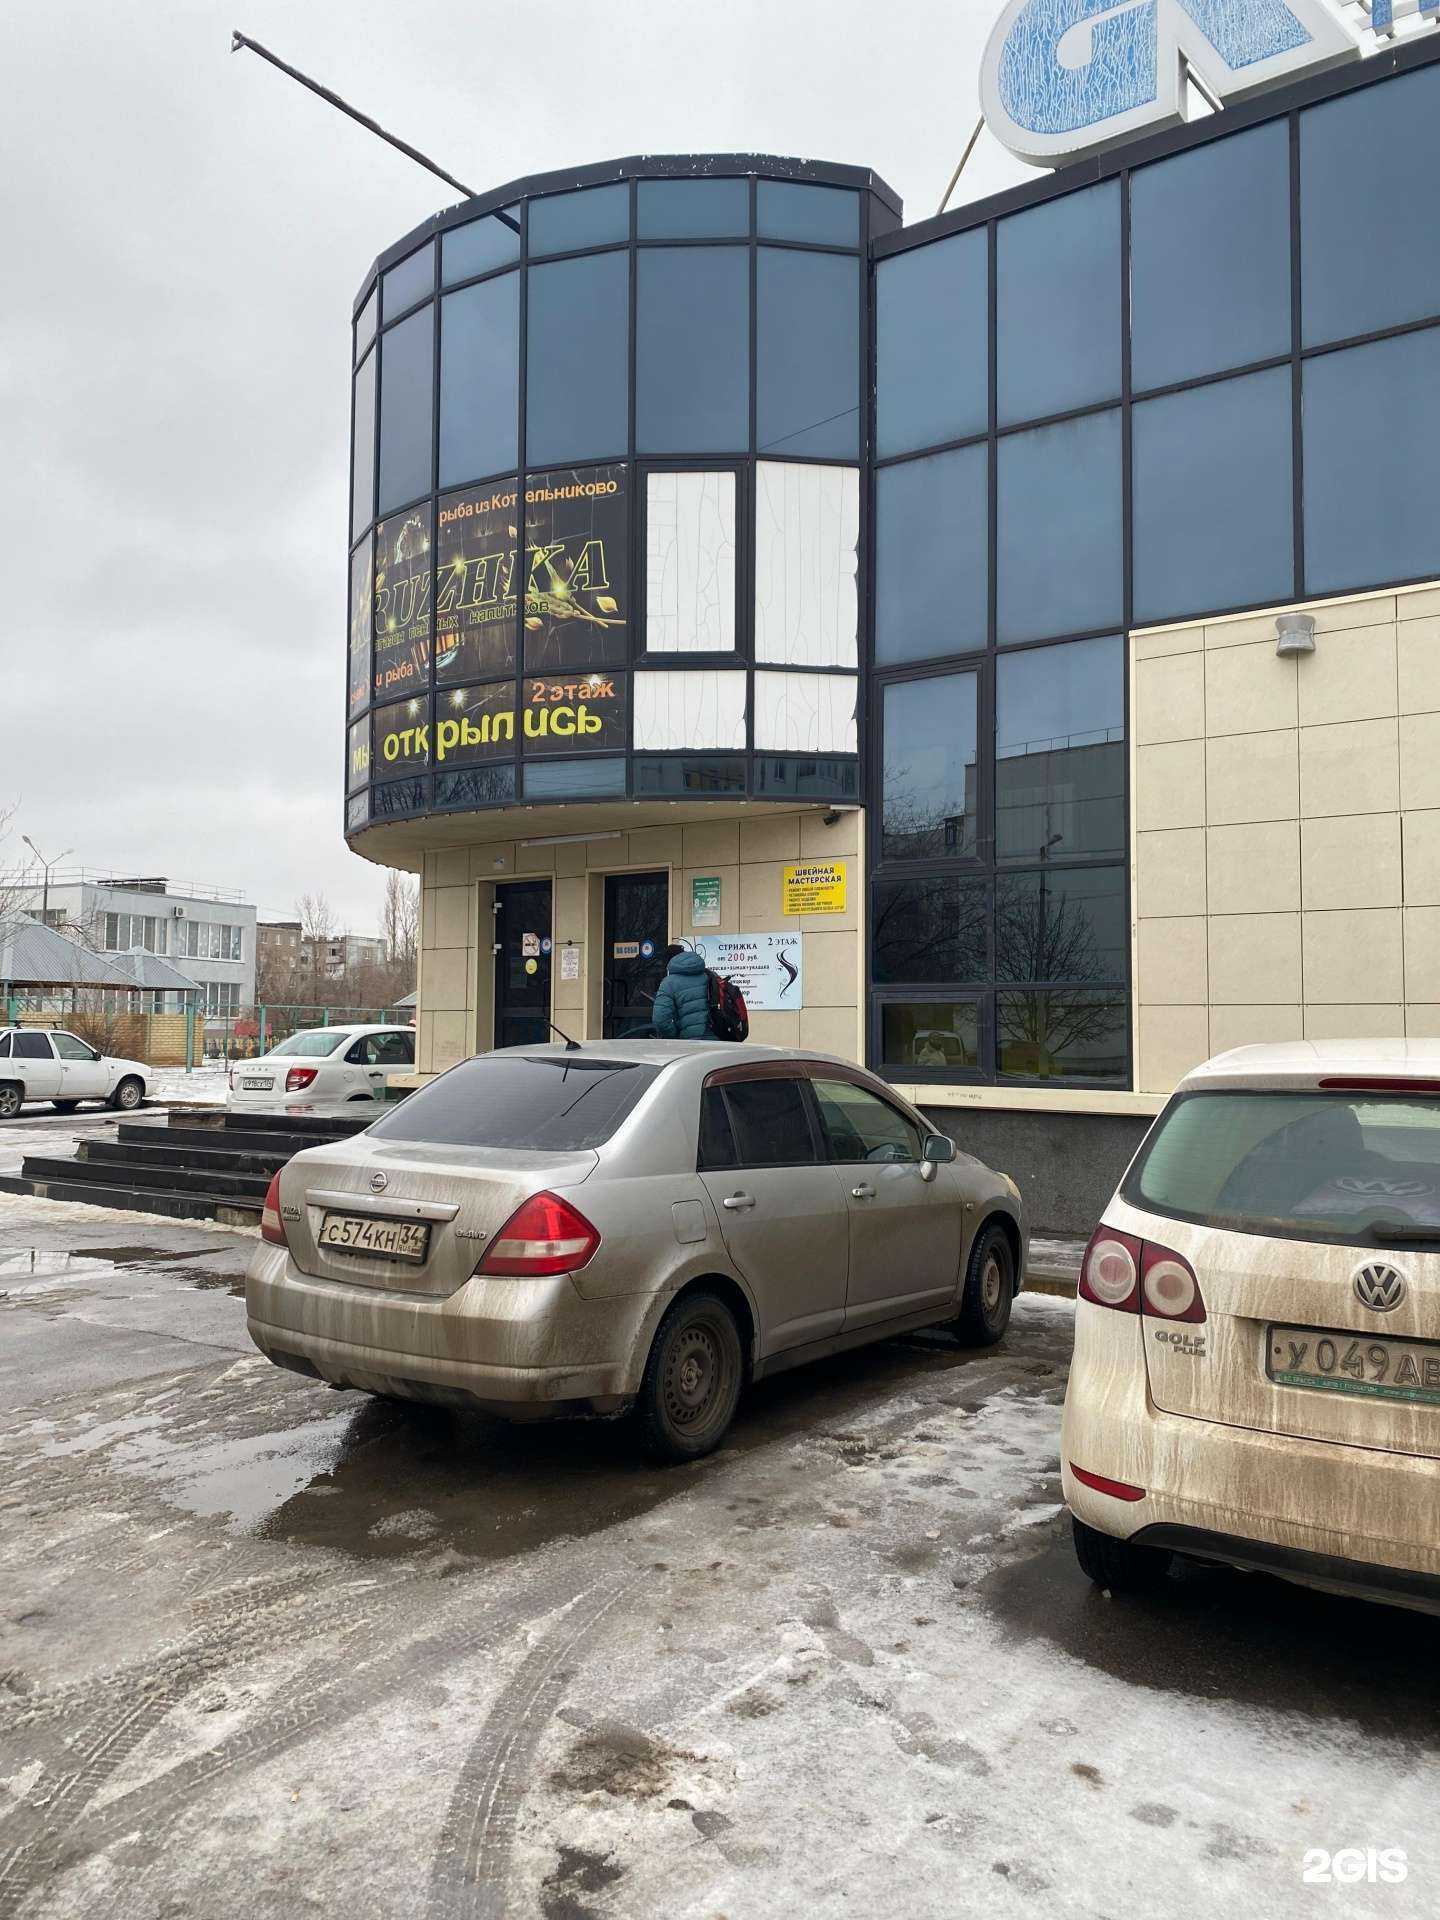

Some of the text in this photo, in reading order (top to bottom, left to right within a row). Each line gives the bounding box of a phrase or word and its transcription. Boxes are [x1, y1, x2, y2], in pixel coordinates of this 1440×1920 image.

[439, 480, 618, 527] рыба из Котельниково
[375, 661, 414, 688] и рыба
[531, 680, 616, 703] 2 этаж
[795, 867, 835, 876] ШВЕЙНАЯ
[788, 876, 842, 885] МАСТЕРСКАЯ
[707, 897, 718, 907] 22
[718, 943, 757, 951] СТРИЖКА
[768, 937, 798, 946] 2 ЭТАЖ
[727, 953, 745, 961] 200
[328, 1220, 418, 1251] С574КН 34
[1154, 1331, 1206, 1347] GOLF
[1173, 1345, 1206, 1357] PLUS
